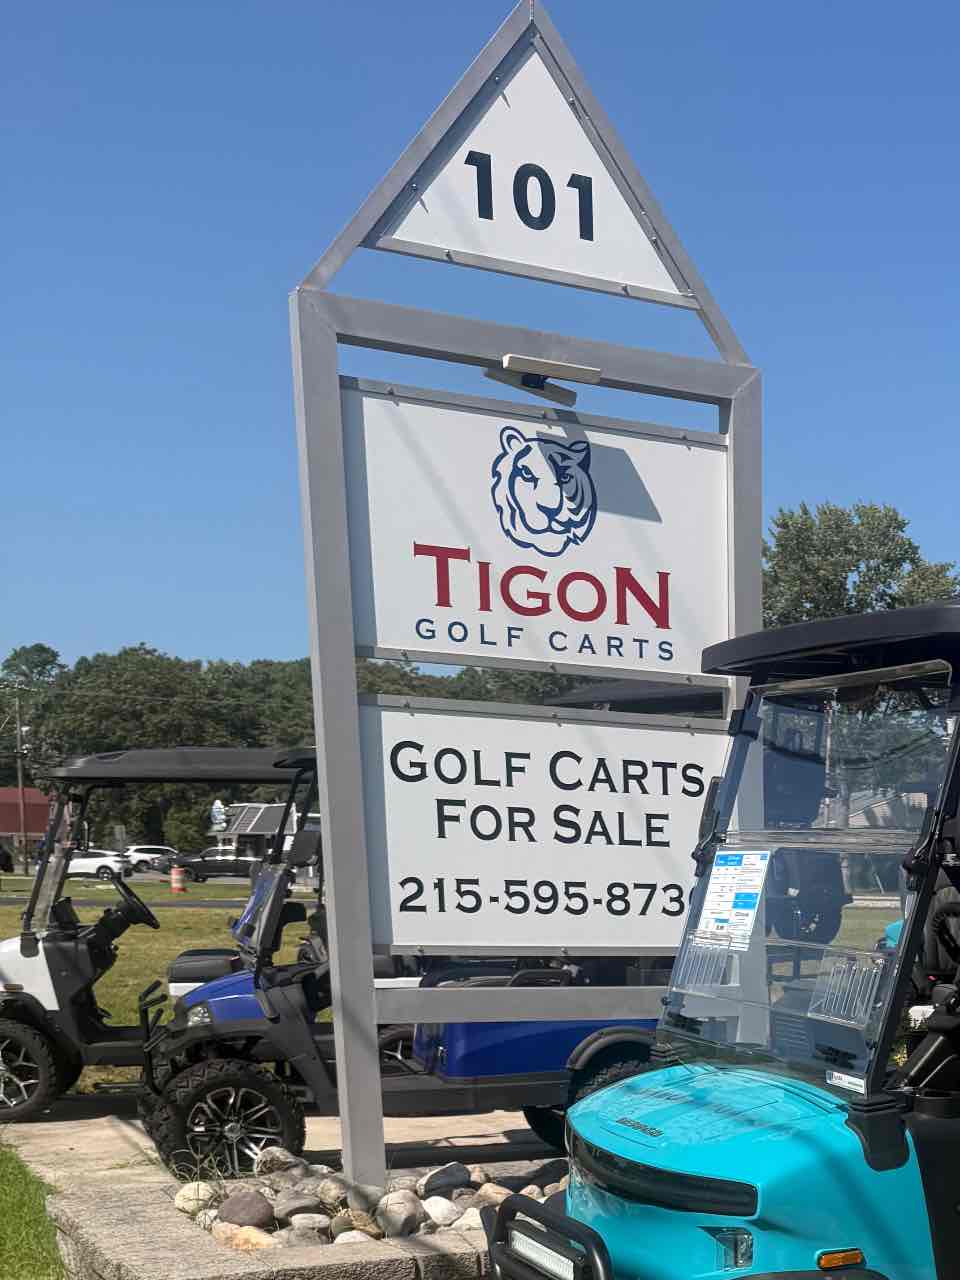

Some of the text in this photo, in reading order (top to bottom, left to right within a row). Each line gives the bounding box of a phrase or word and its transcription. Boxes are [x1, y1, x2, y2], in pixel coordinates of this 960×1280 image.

[464, 150, 594, 241] 101
[413, 541, 672, 630] TIGON
[415, 618, 674, 661] GOLF CARTS
[389, 740, 705, 798] GOLF CARTS
[435, 798, 671, 848] FOR SALE
[399, 876, 694, 917] 215-595-873
